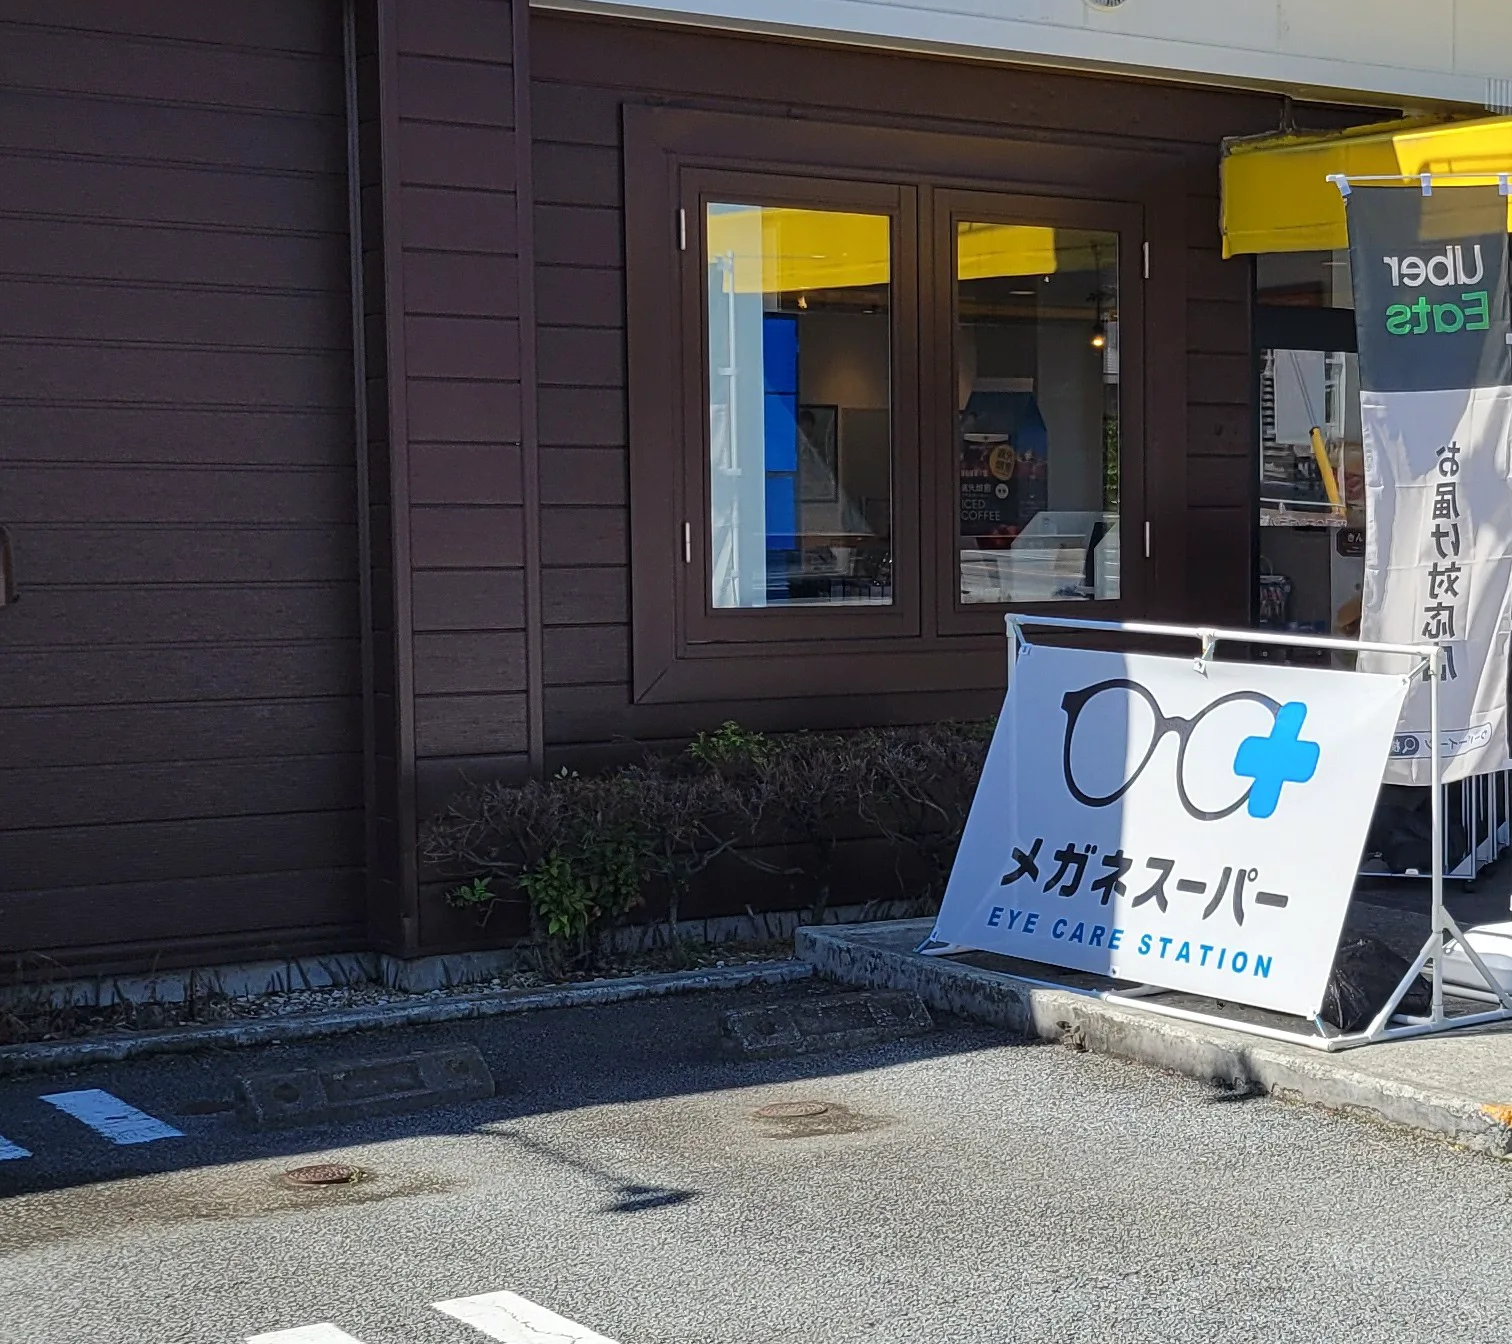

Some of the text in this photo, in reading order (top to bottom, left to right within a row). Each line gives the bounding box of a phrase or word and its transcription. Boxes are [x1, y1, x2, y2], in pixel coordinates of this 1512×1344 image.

[960, 510, 1001, 521] COFFEE
[1000, 838, 1289, 927] メガネスーパー
[986, 905, 1273, 979] EYE CARE STATION
